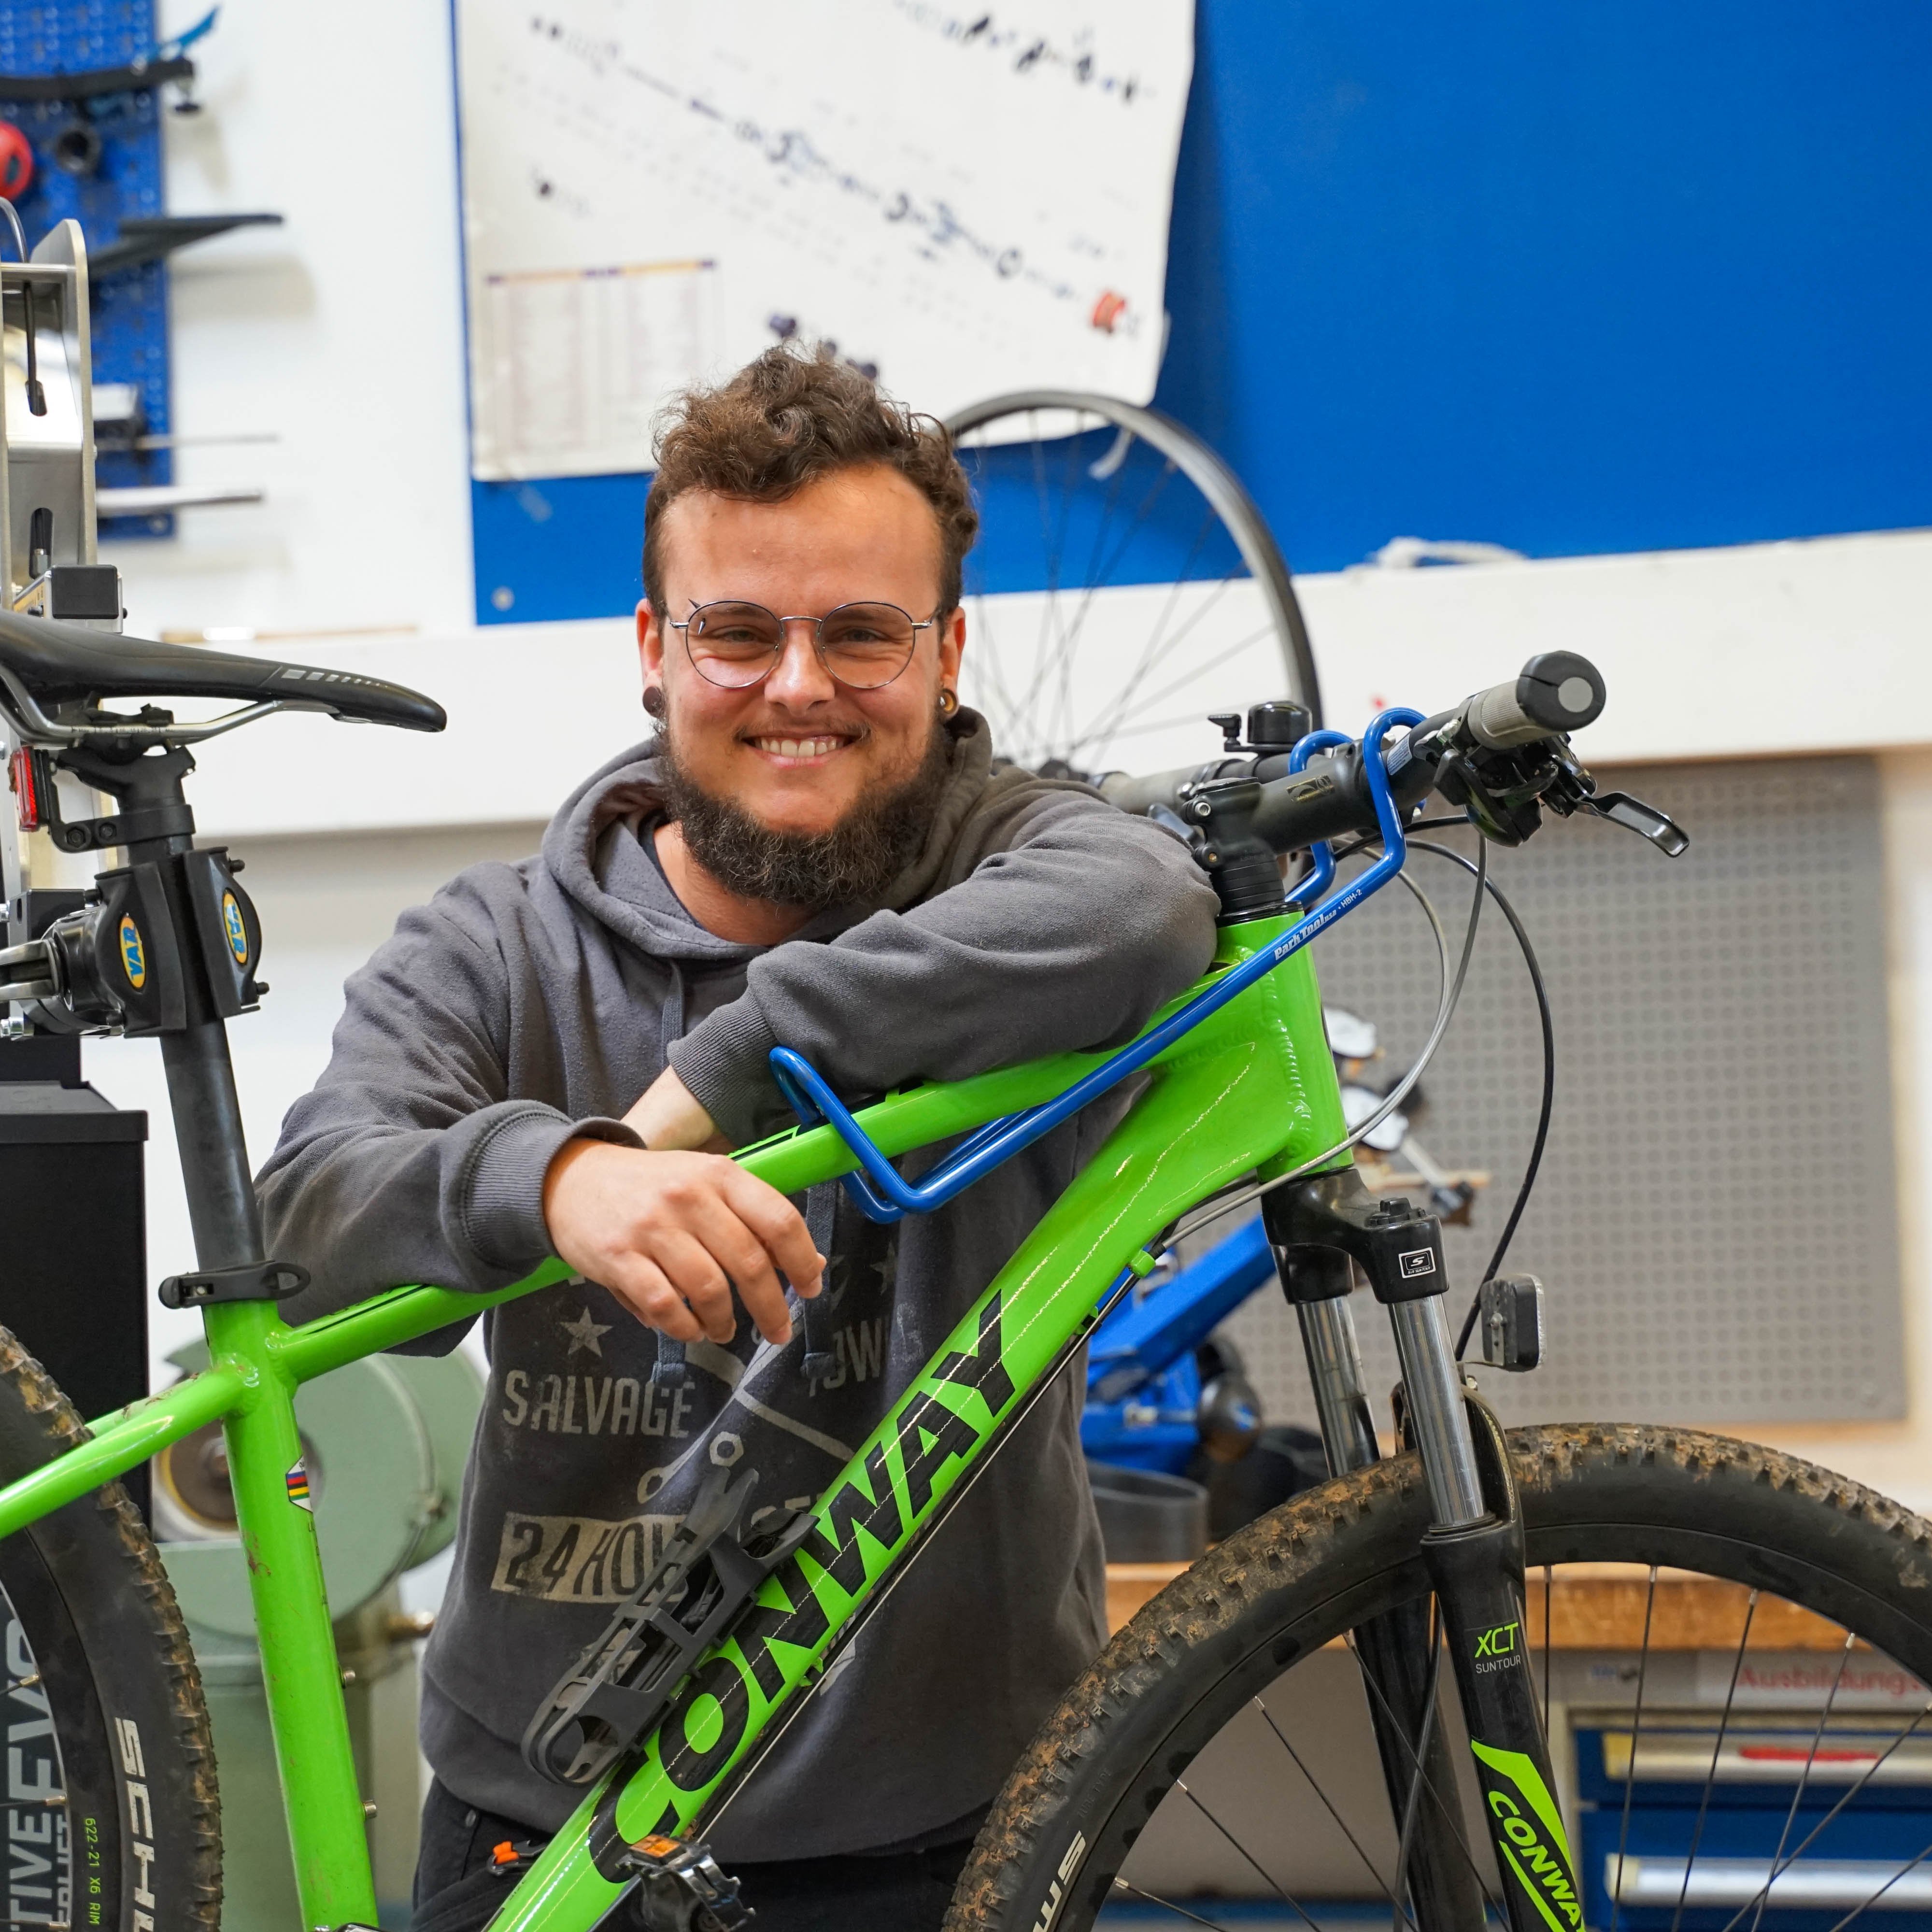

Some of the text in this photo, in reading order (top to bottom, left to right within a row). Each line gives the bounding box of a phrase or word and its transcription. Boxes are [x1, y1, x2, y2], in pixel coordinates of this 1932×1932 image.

[1340, 889, 1363, 908] HBH-2
[122, 926, 143, 980] VAR
[225, 901, 245, 954] VAR
[502, 1369, 696, 1438] SALVAGE
[588, 1288, 1016, 1884] CONWAY
[1475, 1622, 1519, 1658] XCT
[1476, 1655, 1521, 1674] SUNTOUR
[85, 1818, 100, 1867] 622-21
[1488, 1790, 1587, 1932] CONWA
[88, 1902, 101, 1926] RIM
